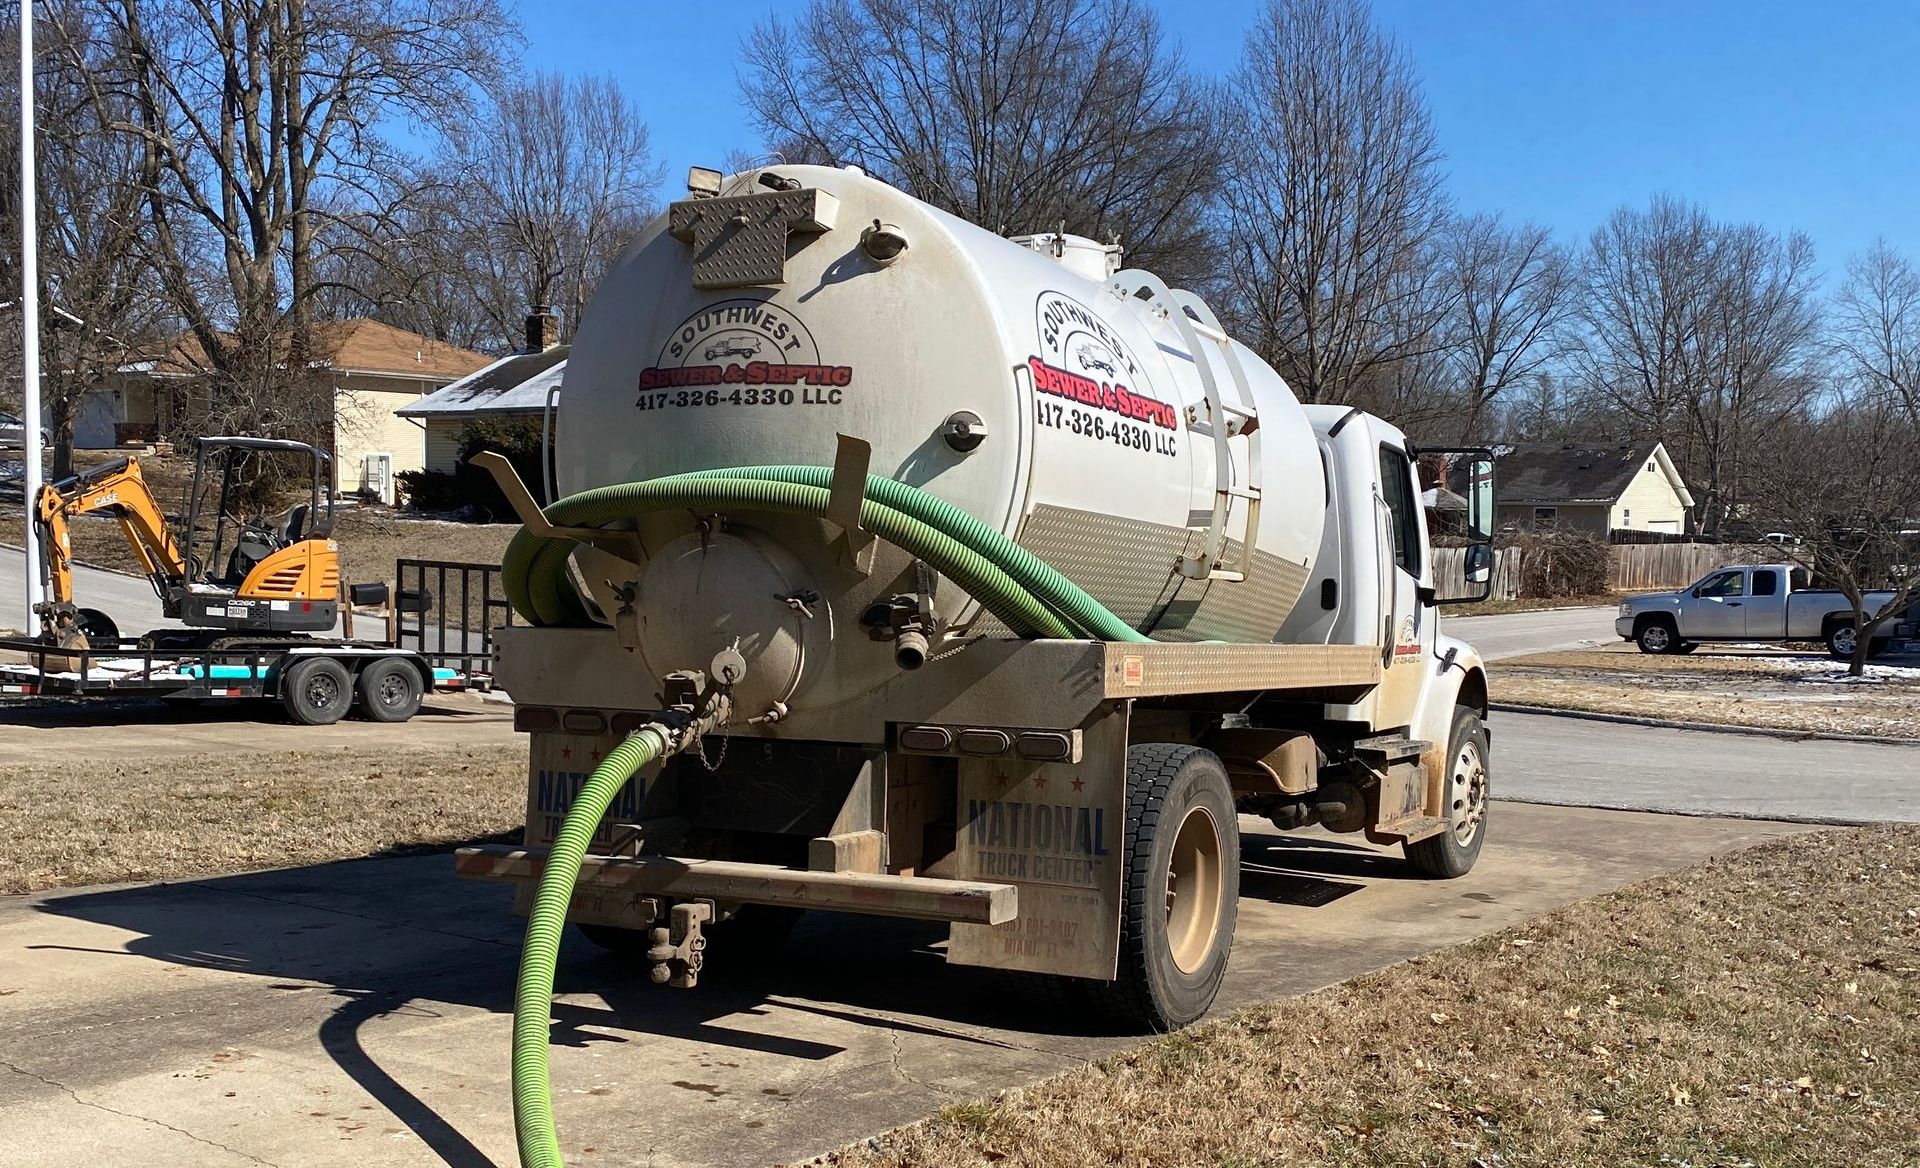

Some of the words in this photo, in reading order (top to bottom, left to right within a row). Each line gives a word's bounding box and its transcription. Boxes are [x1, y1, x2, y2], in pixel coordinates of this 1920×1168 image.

[669, 306, 801, 358] SOUTHWEST
[1043, 299, 1138, 376] SOUTHWEST
[635, 388, 795, 411] 417-326-4330
[802, 388, 842, 405] LLC
[1154, 431, 1177, 458] LLC
[94, 492, 118, 506] CASE
[968, 799, 1110, 857] NATIONAL
[977, 850, 1027, 879] TRUCK
